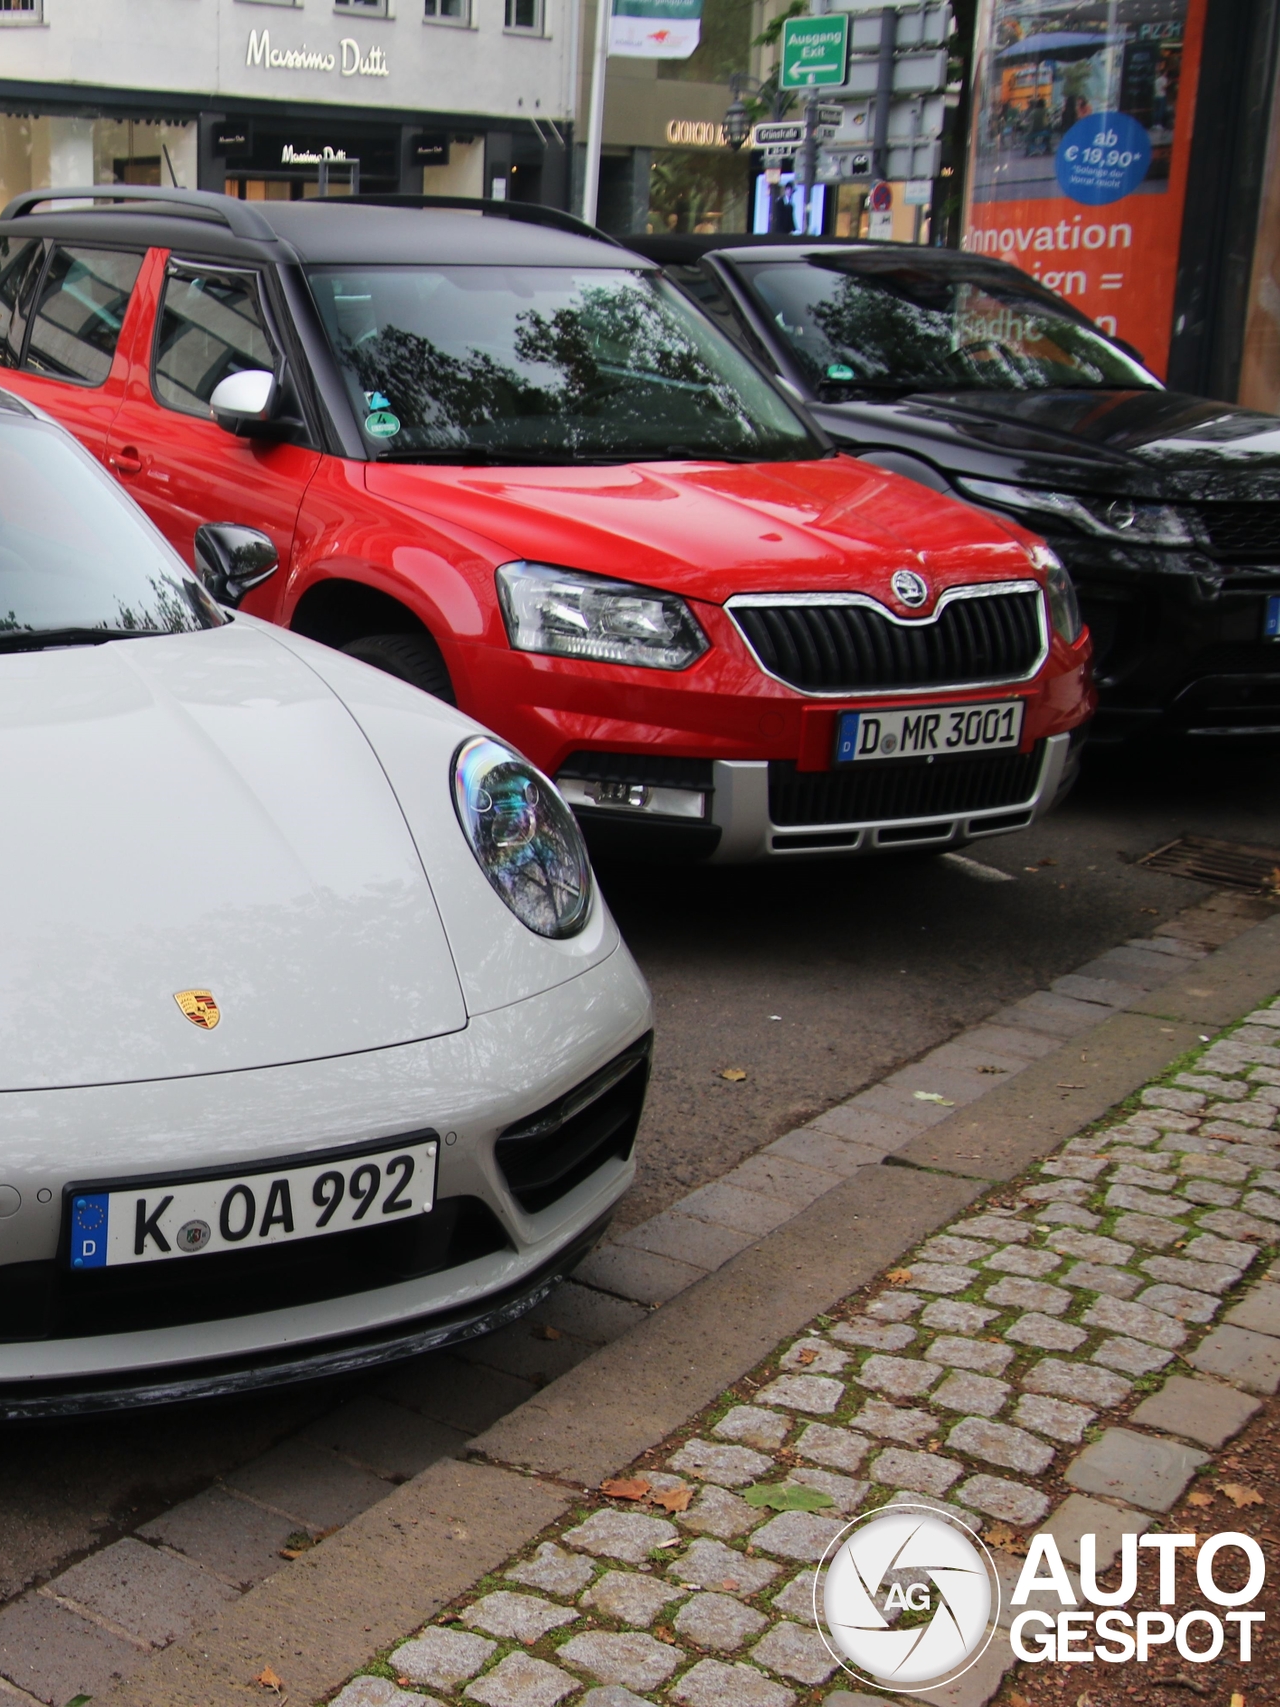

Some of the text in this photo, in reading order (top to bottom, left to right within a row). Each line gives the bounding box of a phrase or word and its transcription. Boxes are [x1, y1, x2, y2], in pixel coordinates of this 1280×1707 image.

[787, 31, 842, 46] Ausgang
[246, 29, 389, 77] Massimo Dutti
[801, 45, 825, 59] Exit
[667, 119, 715, 146] GIORGIO
[1092, 128, 1118, 148] ab
[281, 144, 323, 163] Massimo
[1064, 145, 1079, 162] €
[967, 214, 1132, 253] Innovation
[842, 707, 1015, 755] D D MR 3001
[83, 1154, 415, 1256] D K OA 992
